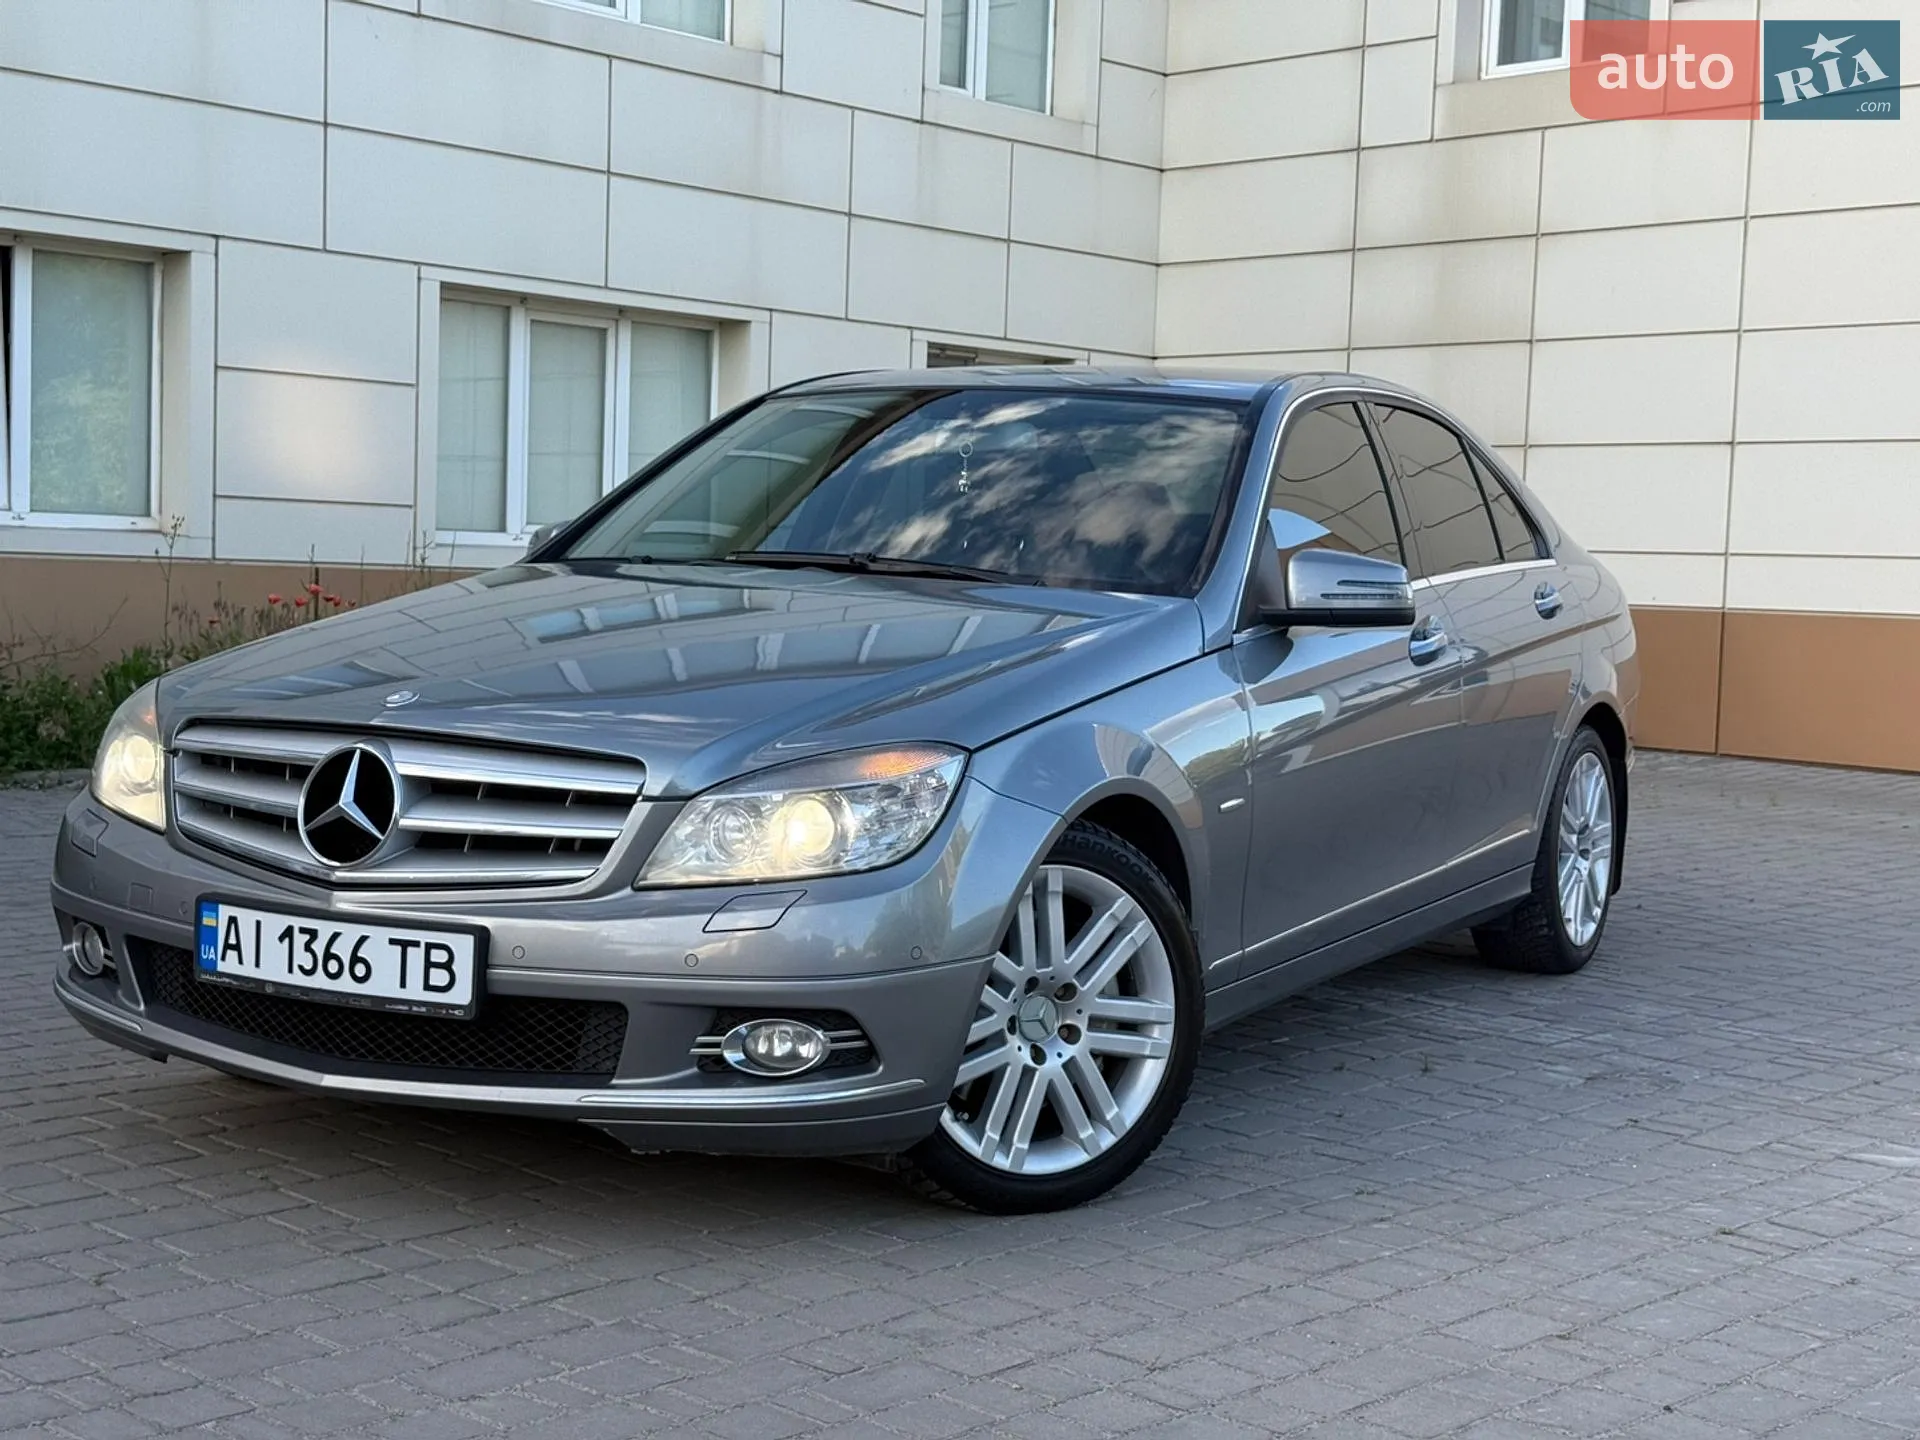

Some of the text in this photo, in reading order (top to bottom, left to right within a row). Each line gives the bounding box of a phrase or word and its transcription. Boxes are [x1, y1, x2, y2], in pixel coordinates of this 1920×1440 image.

[201, 944, 216, 961] UA
[220, 915, 457, 994] AI 1366 TB
